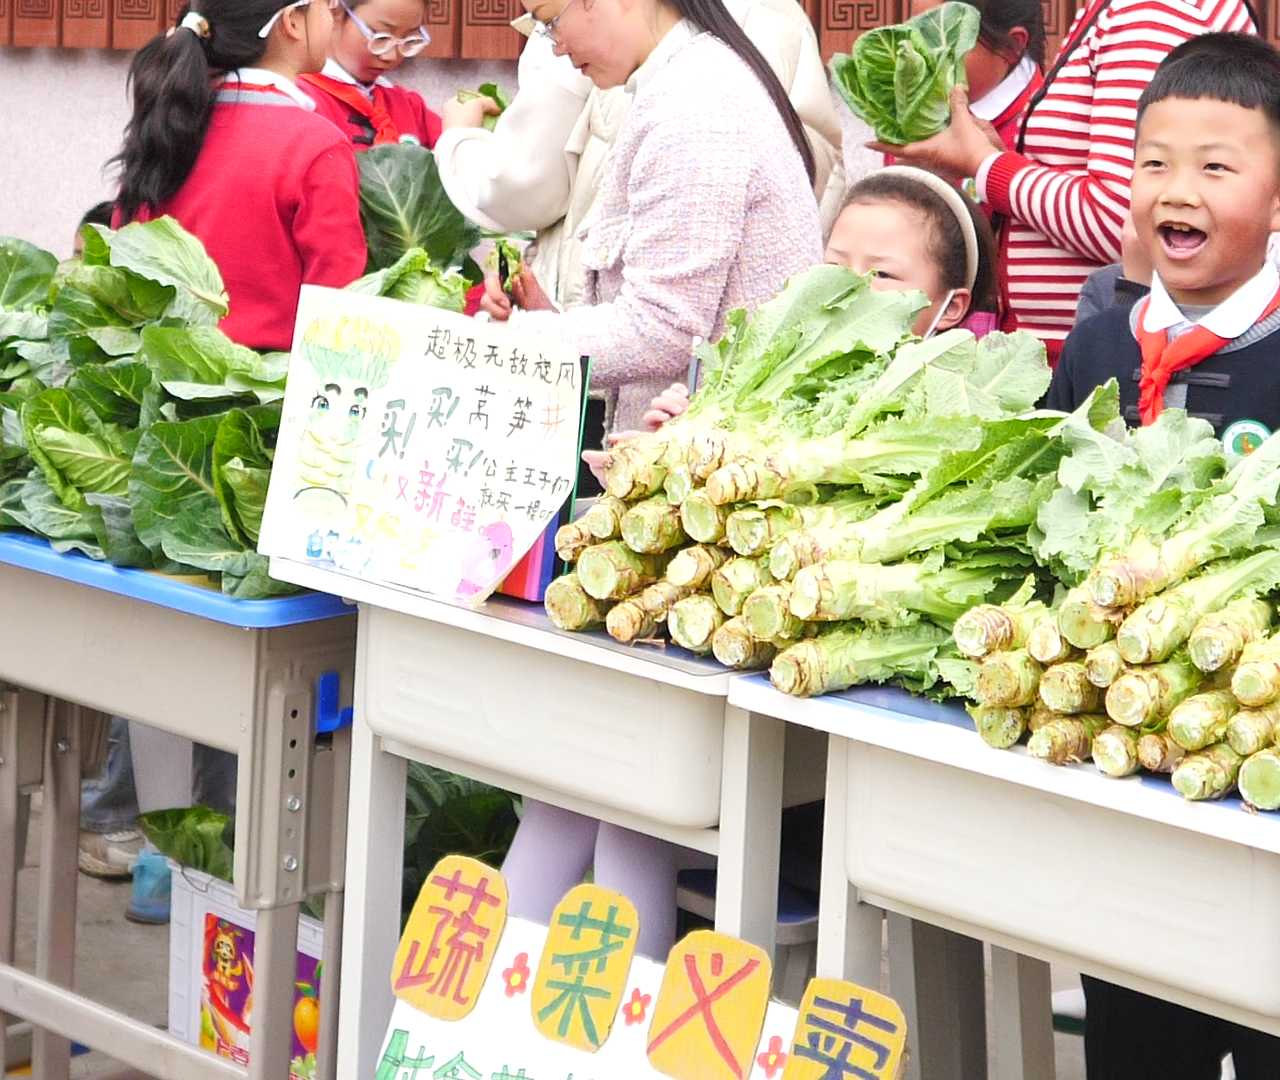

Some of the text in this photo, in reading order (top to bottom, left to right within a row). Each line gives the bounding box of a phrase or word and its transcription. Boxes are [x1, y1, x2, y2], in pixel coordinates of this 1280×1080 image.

[424, 324, 577, 390] 超极无敌旋风
